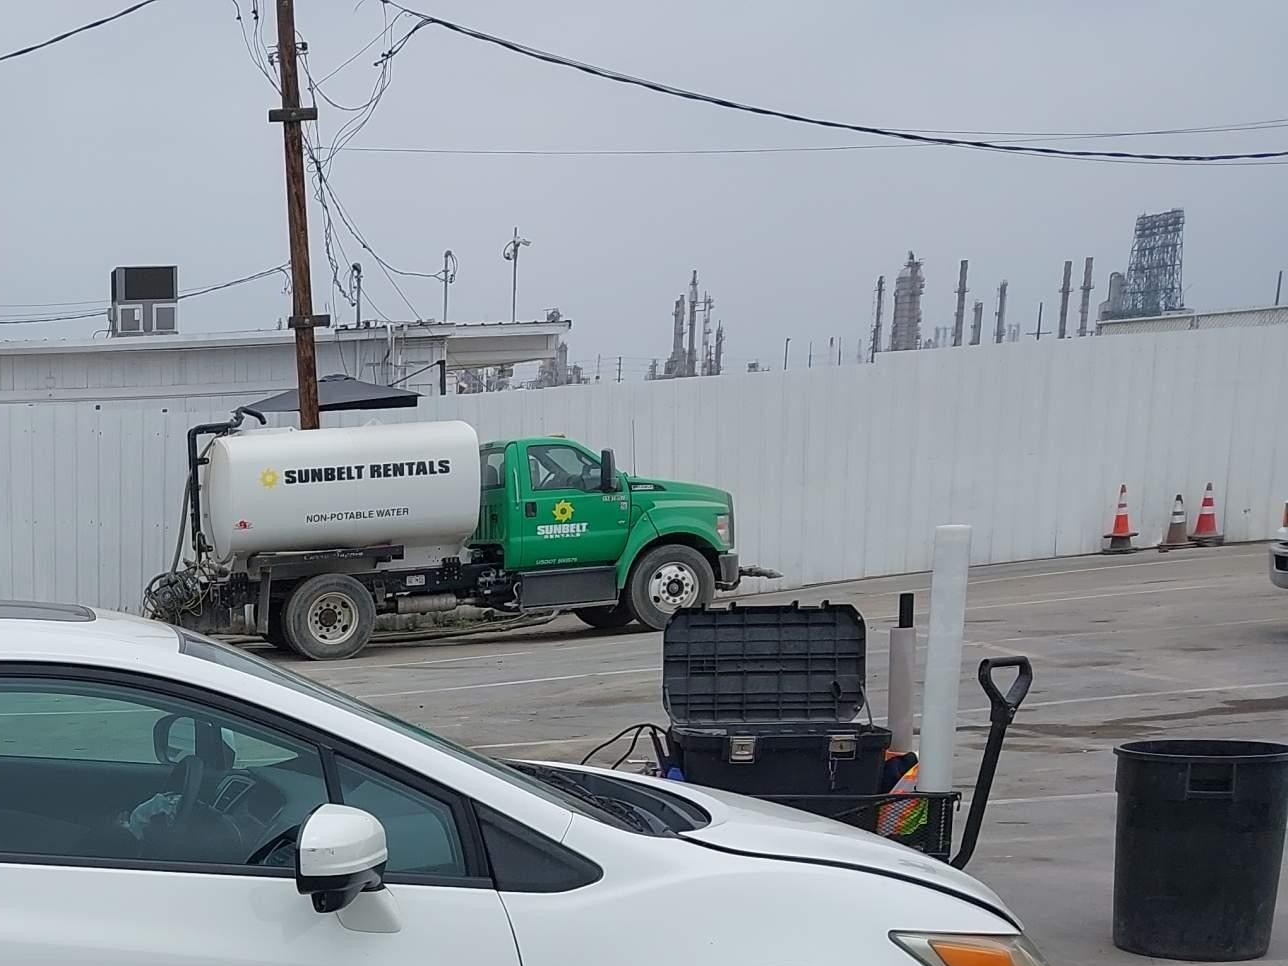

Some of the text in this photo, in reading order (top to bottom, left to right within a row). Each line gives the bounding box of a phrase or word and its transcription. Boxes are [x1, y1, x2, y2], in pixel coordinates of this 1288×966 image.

[284, 459, 451, 485] SUNBELT RENTALS
[306, 507, 410, 524] NON-POTABLE WATER
[536, 522, 589, 536] SUNBELT
